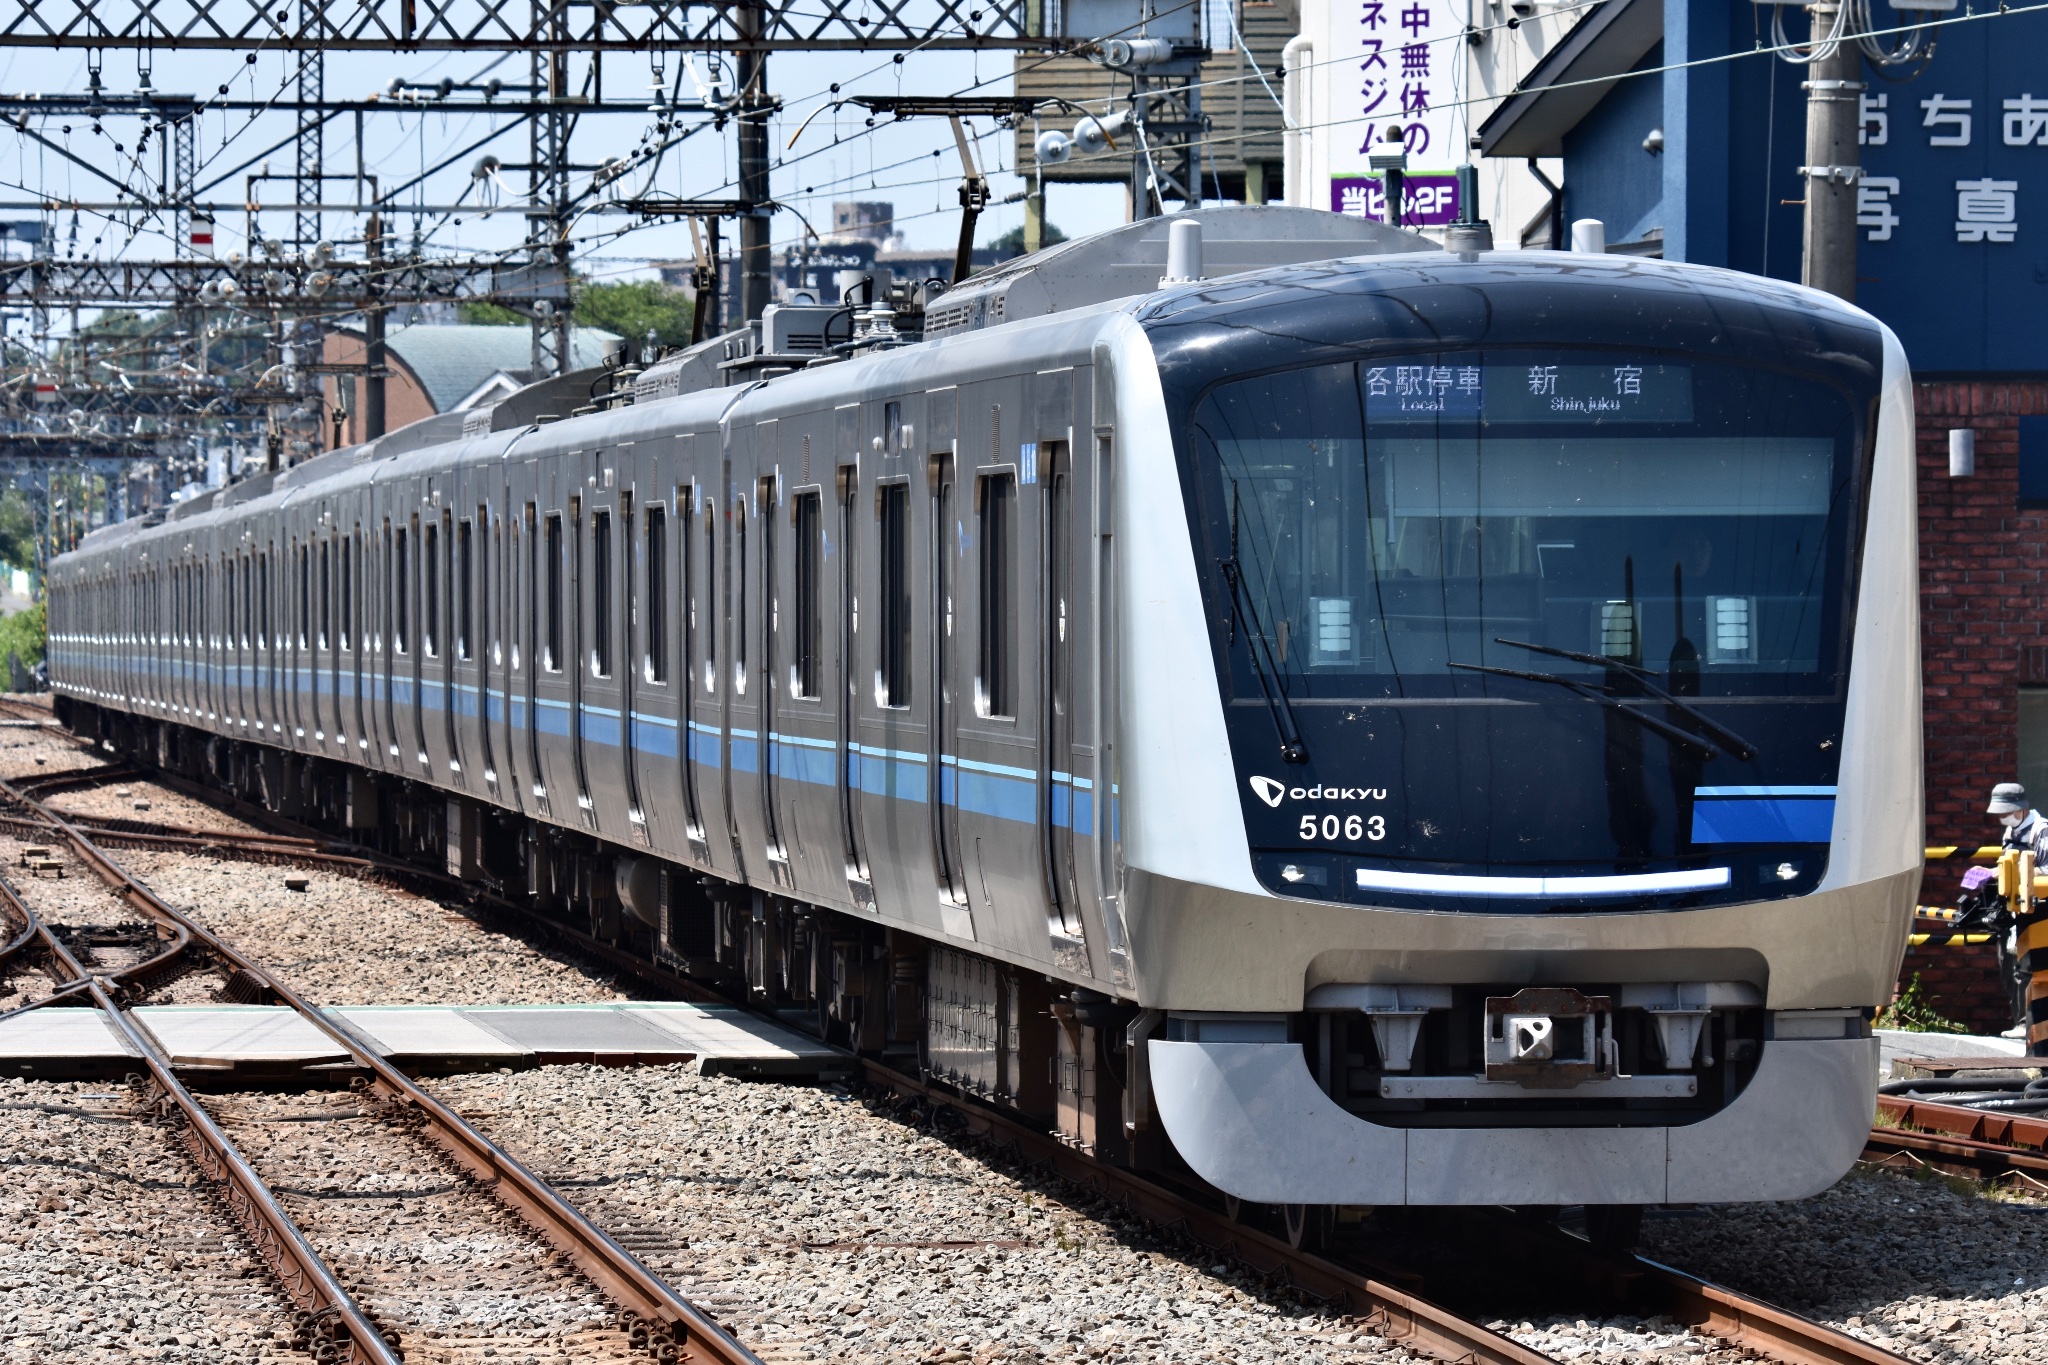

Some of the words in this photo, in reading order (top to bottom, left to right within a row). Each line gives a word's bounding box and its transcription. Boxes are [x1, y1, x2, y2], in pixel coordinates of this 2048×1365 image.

[1400, 2, 1430, 155] 中無休の
[1366, 365, 1482, 396] 各駅停車
[1401, 397, 1446, 411] Local
[1550, 397, 1621, 413] Shinjuku
[1299, 814, 1386, 841] 5063
